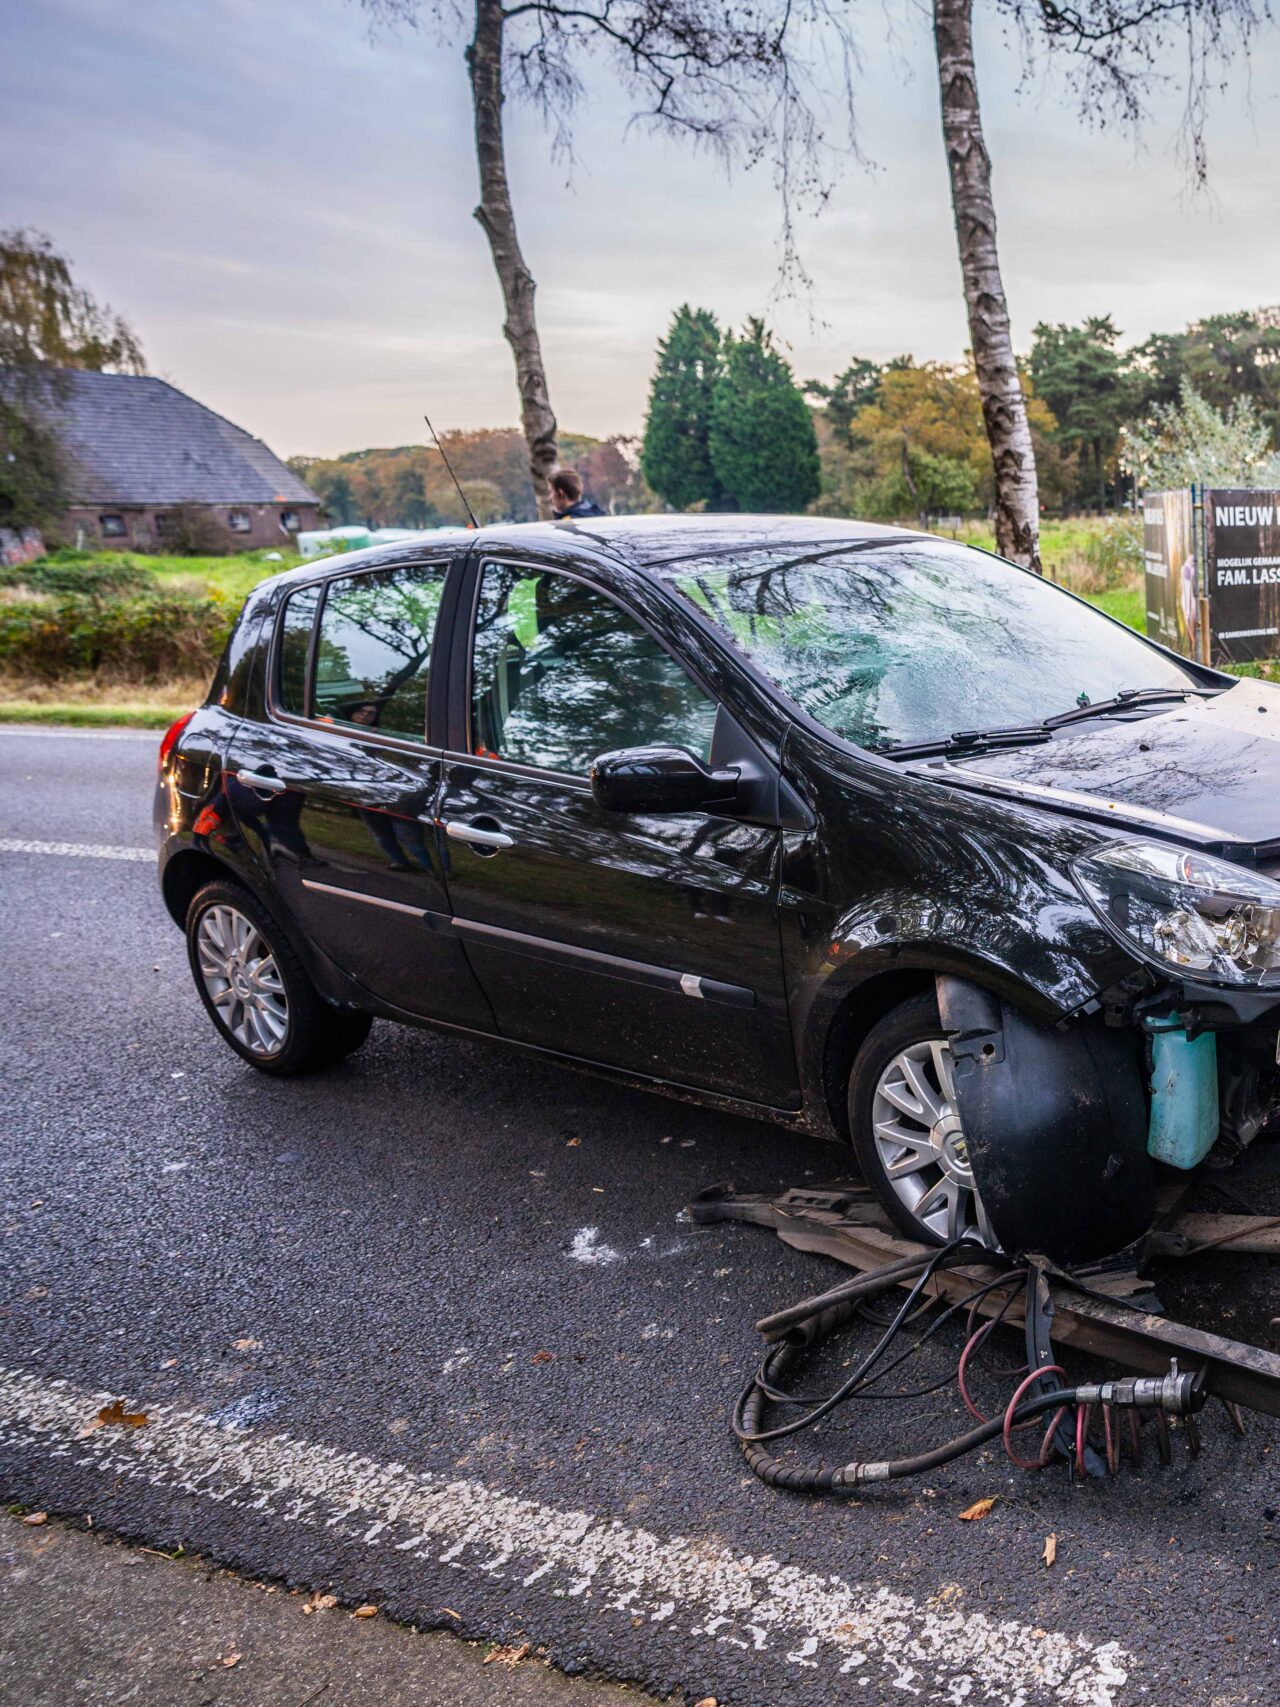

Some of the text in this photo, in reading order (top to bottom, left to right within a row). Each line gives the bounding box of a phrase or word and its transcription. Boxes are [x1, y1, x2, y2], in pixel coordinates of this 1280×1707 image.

[1215, 506, 1273, 526] NIEUW
[1217, 557, 1252, 568] MOGELIJK
[1217, 569, 1251, 586] FAM.
